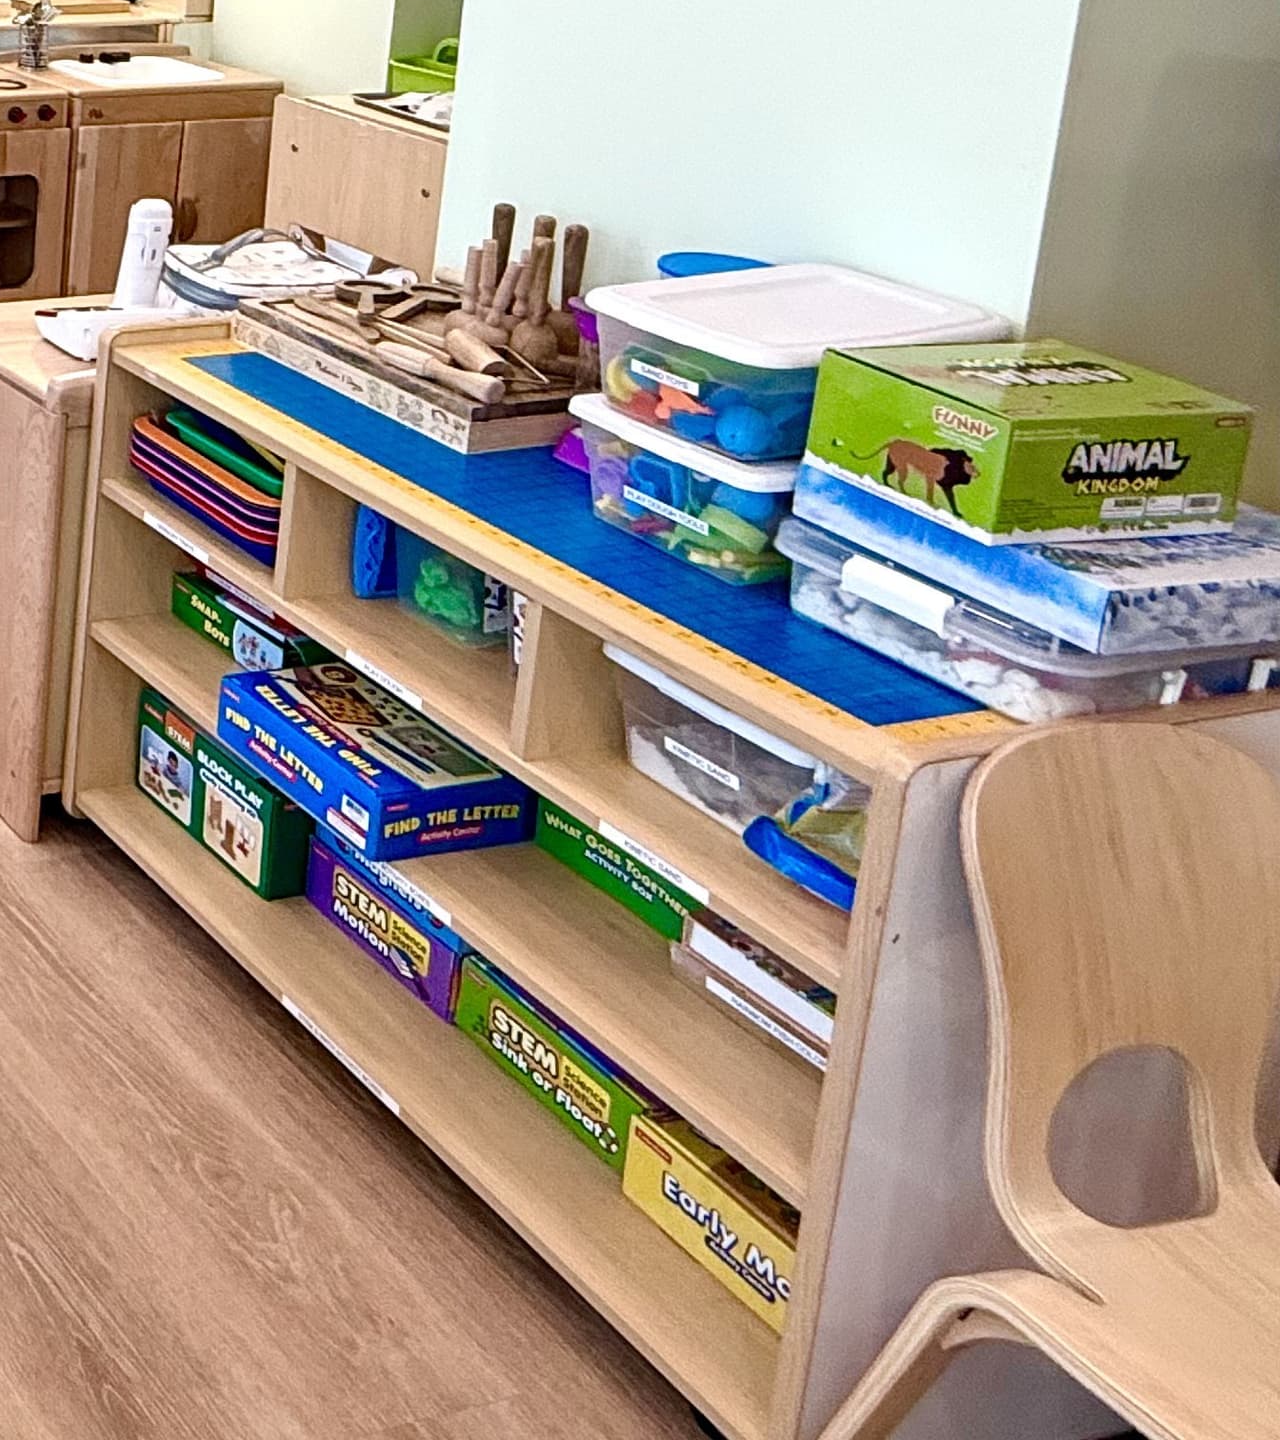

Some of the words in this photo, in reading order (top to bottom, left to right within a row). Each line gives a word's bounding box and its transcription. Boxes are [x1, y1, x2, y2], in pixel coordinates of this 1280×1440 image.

[935, 408, 996, 438] FUNNY
[1068, 440, 1186, 474] ANIMAL
[1076, 476, 1162, 495] KINGDOM
[190, 594, 222, 624] SNAP-
[204, 619, 231, 647] BOTS
[167, 726, 191, 752] STEM
[225, 707, 251, 731] FIND
[254, 724, 277, 752] THE
[280, 744, 324, 794] LETTER
[197, 749, 233, 787] BLOCK
[234, 779, 264, 810] PLAY
[383, 816, 421, 839] FIND
[426, 808, 458, 827] THE
[462, 804, 521, 822] LETTER
[420, 829, 452, 842] Activity
[452, 825, 481, 837] Center
[544, 811, 582, 840] WHAT
[585, 834, 621, 866] GOES
[624, 858, 689, 917] TOGETHER
[584, 848, 631, 883] ACTIVITY
[631, 879, 654, 903] BOX
[336, 873, 387, 932] STEM
[333, 898, 390, 957] Motion
[390, 931, 425, 965] Station
[392, 919, 428, 955] Science
[493, 1007, 558, 1077] STEM
[491, 1031, 529, 1074] Sink
[531, 1070, 553, 1093] or
[555, 1088, 604, 1138] Float
[562, 1076, 603, 1119] Station
[564, 1064, 608, 1110] Science
[663, 1172, 738, 1251] Early
